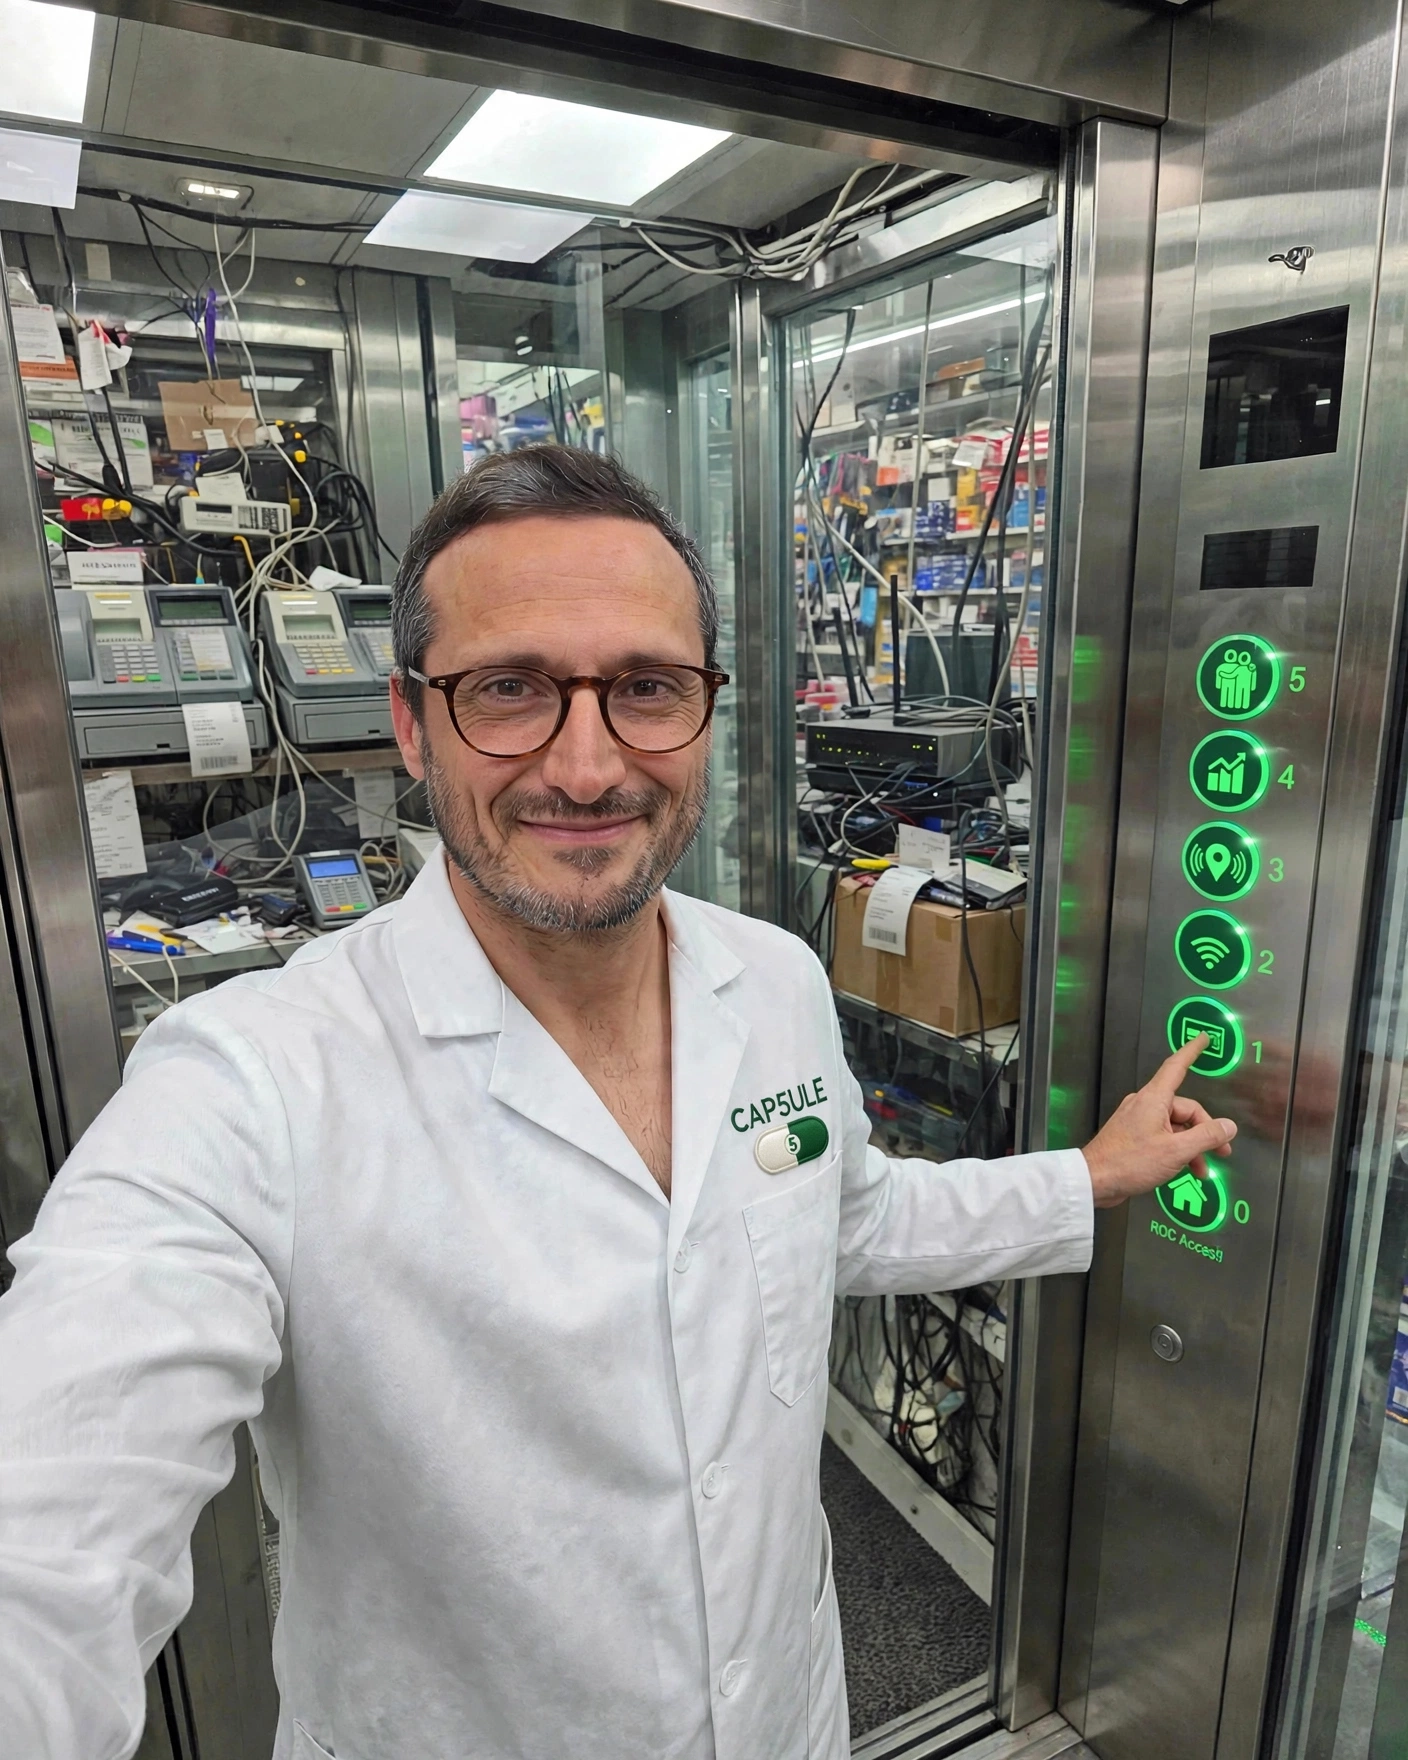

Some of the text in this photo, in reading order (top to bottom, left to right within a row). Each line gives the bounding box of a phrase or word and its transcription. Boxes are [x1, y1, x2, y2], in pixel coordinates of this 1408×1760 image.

[1288, 666, 1306, 693] 5
[1277, 764, 1295, 790] 4
[1267, 857, 1285, 883] 3
[1257, 949, 1275, 975] 2
[1251, 1040, 1262, 1064] 1
[730, 1076, 828, 1133] CAP5ULE
[788, 1136, 798, 1152] 5
[1233, 1199, 1250, 1225] 0
[1150, 1219, 1177, 1242] ROC
